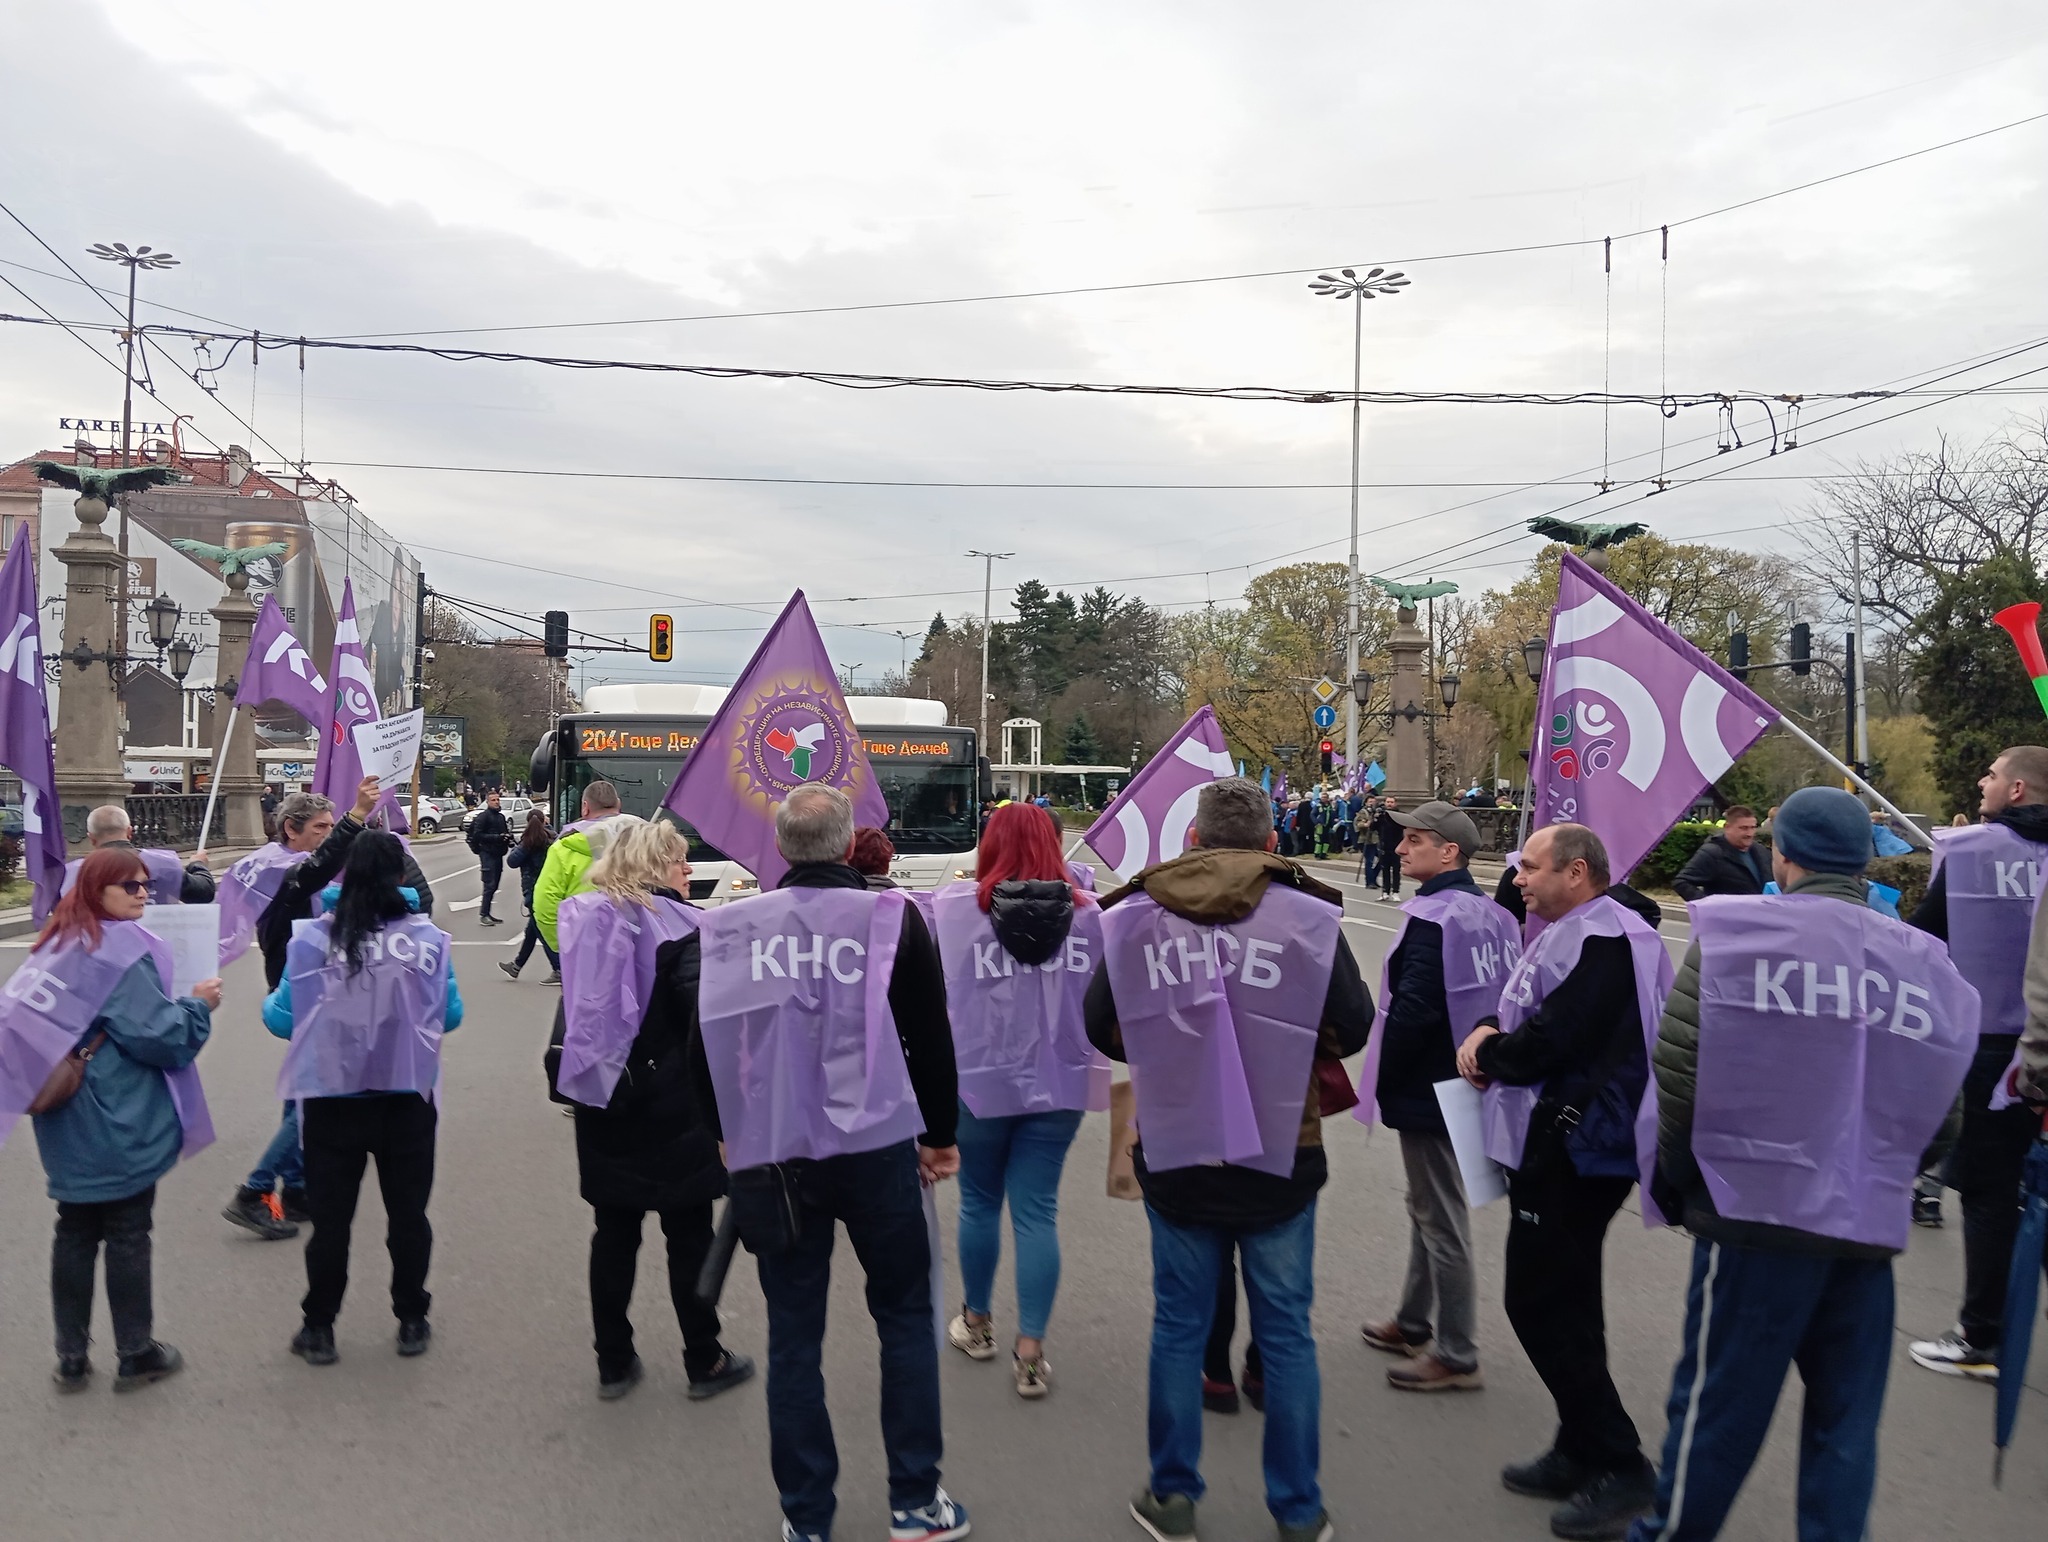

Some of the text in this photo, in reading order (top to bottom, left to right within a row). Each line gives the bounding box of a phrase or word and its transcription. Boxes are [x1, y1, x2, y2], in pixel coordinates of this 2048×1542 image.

[582, 729, 700, 751] 204 Гоце Дел
[771, 705, 784, 715] НА
[784, 701, 840, 738] НЕЗАВИСИМИТЕ
[862, 740, 949, 755] Гоце Делчев
[1994, 860, 2040, 897] КН
[334, 931, 440, 977] НСБ
[751, 934, 867, 984] КНС
[1143, 928, 1284, 990] КНСБ
[4, 966, 68, 1013] СБ
[1754, 958, 1934, 1041] КНСБ
